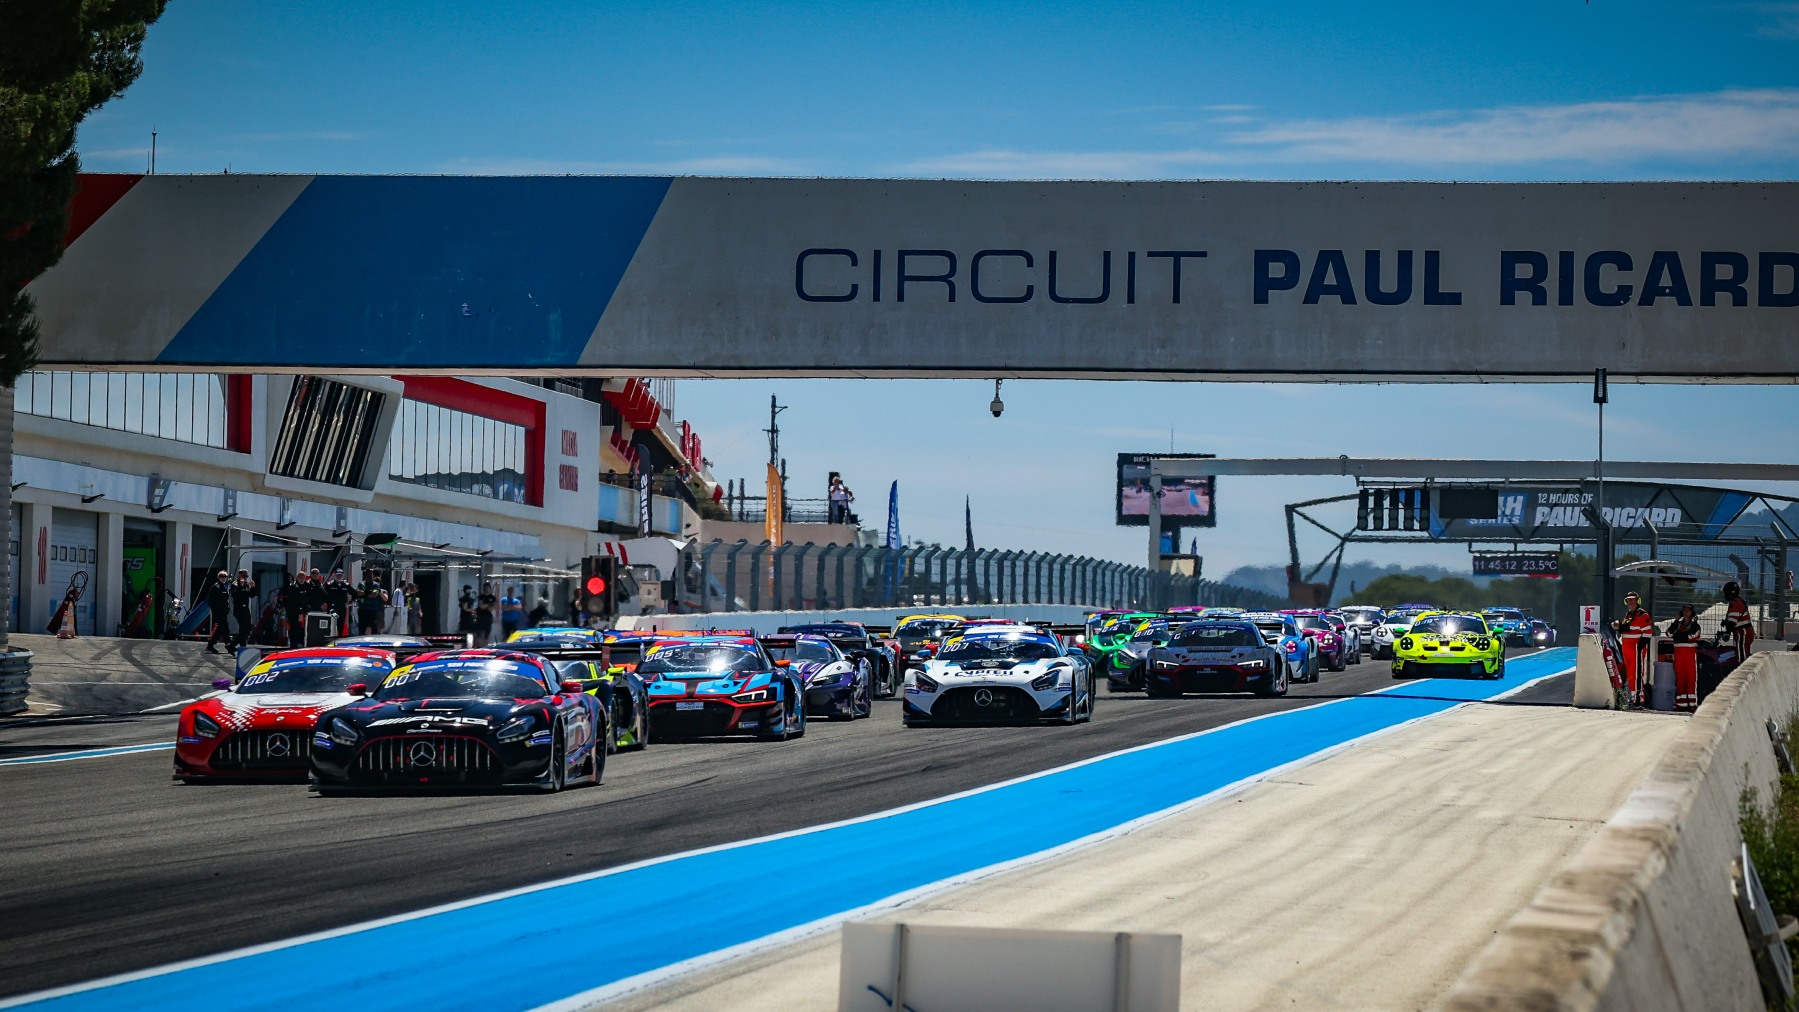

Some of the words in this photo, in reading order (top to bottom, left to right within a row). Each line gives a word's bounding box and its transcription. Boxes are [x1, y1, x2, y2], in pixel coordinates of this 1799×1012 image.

[796, 248, 1207, 304] CIRCUIT
[1253, 249, 1462, 306] PAUL
[1500, 250, 1799, 307] RICARD
[1537, 493, 1548, 504] 12
[1549, 493, 1579, 504] HOURS
[1581, 493, 1594, 505] OF
[1533, 506, 1590, 527] PAUL
[1602, 507, 1682, 528] RICARD
[1473, 560, 1517, 570] 11:45:12
[244, 671, 280, 687] 002
